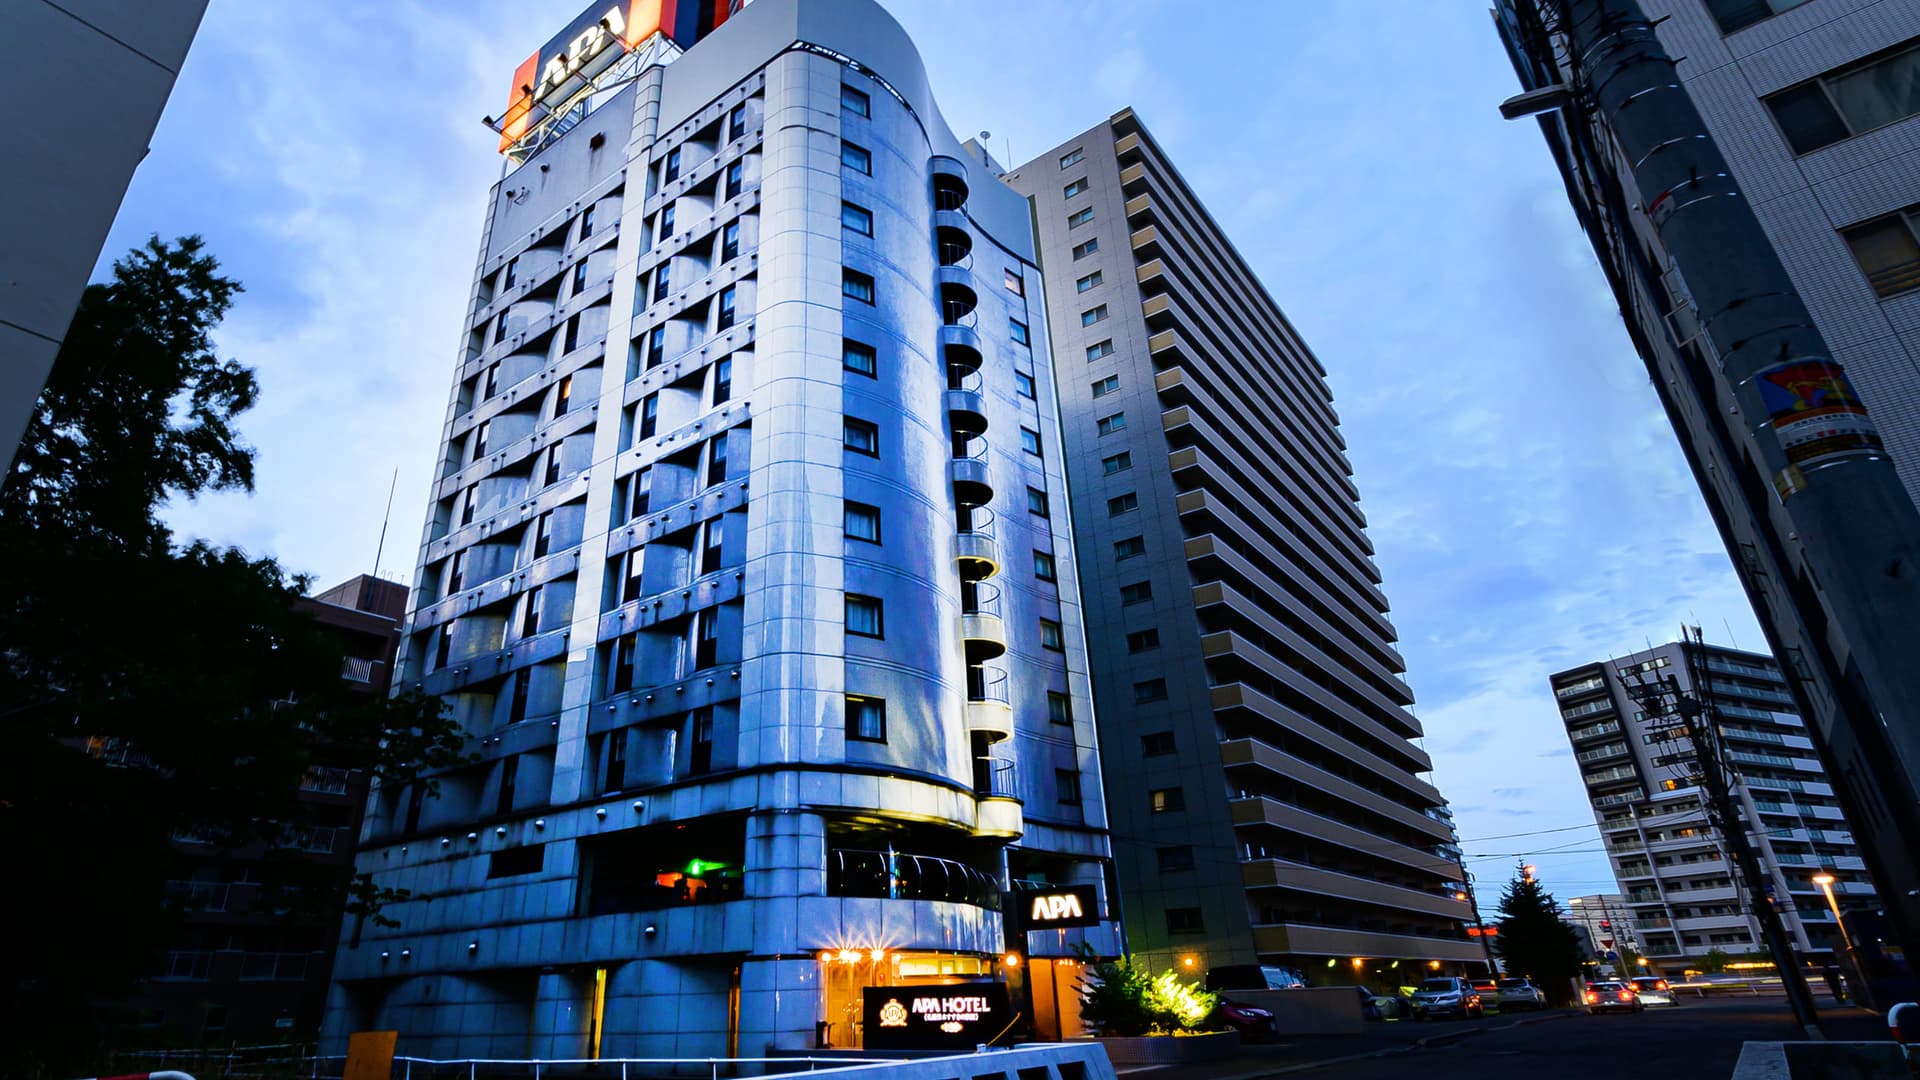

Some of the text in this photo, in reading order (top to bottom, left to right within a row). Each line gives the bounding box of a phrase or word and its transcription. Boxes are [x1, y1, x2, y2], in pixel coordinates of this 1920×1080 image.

[533, 5, 625, 102] APA
[1032, 894, 1083, 920] APA
[912, 996, 991, 1014] APA HOTEL
